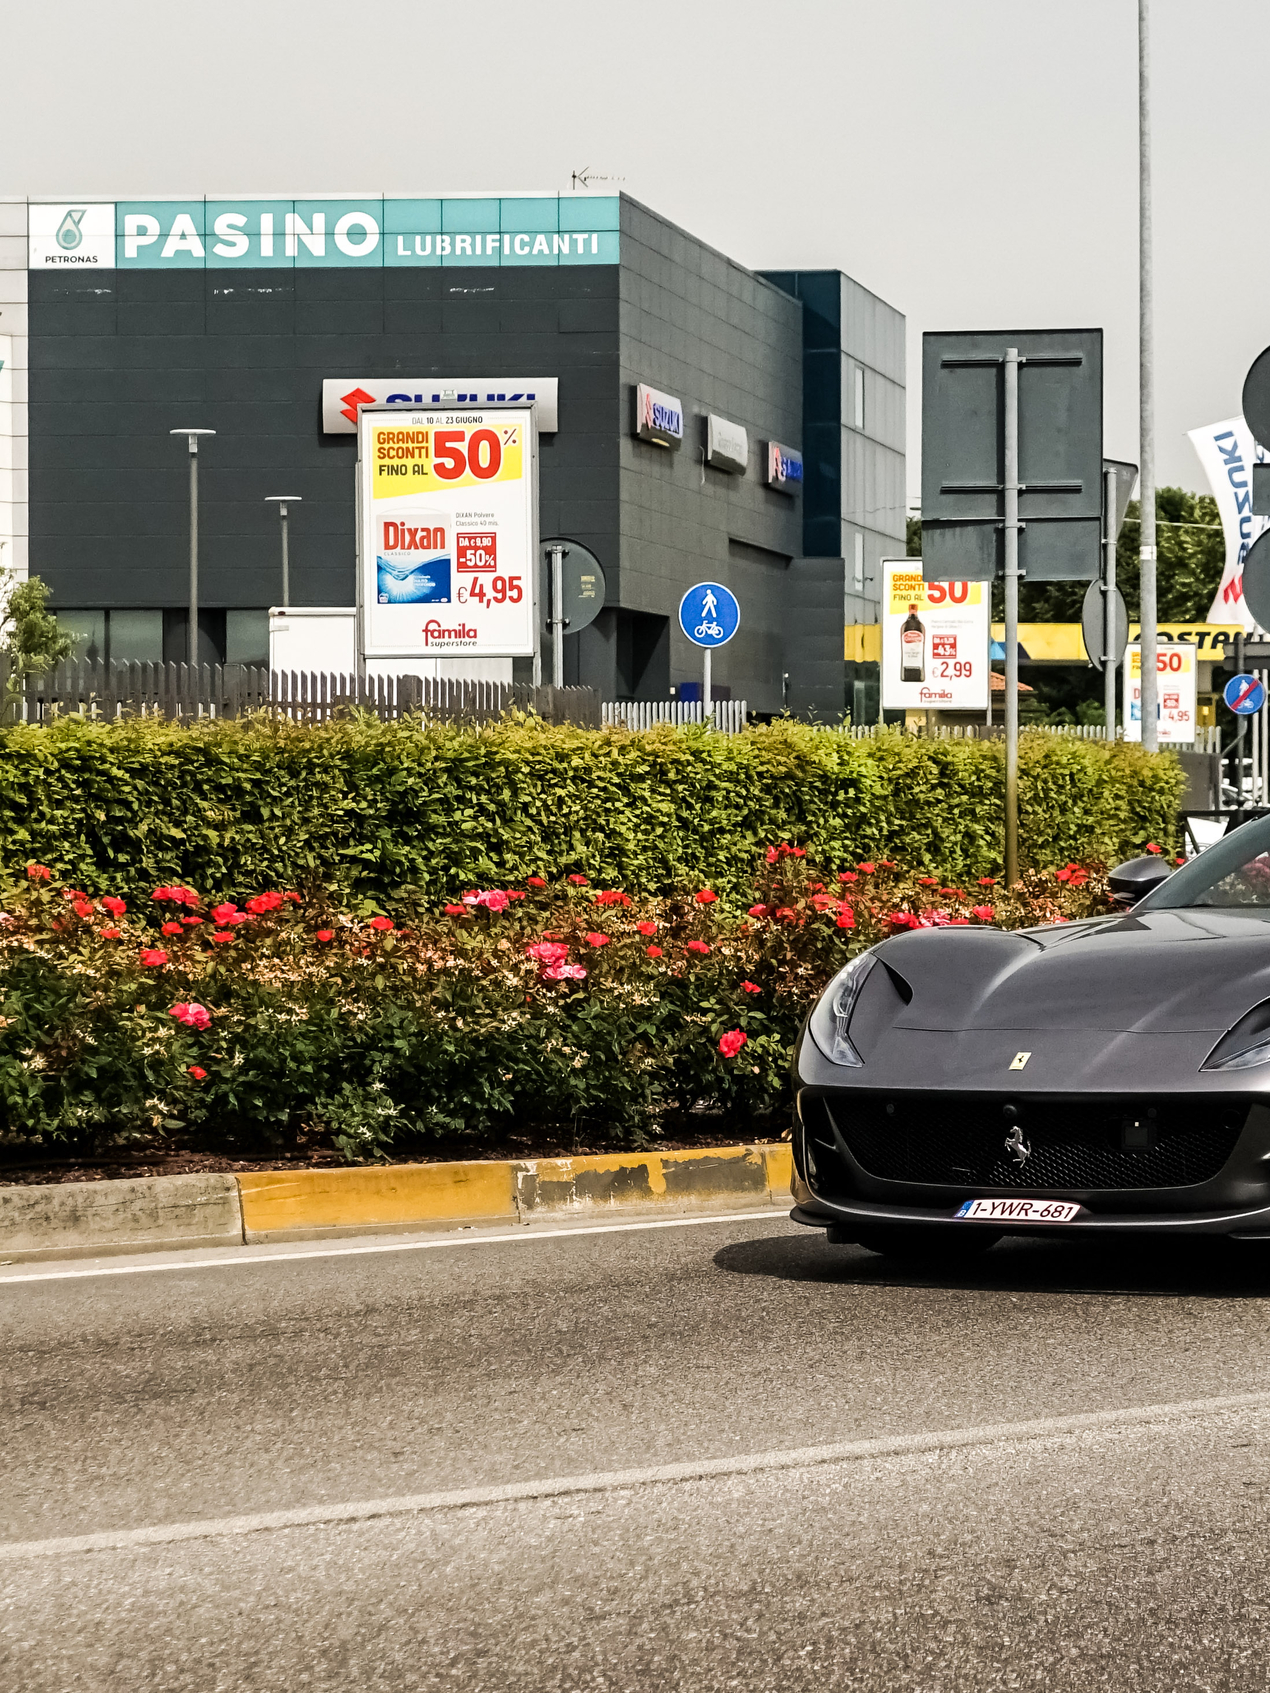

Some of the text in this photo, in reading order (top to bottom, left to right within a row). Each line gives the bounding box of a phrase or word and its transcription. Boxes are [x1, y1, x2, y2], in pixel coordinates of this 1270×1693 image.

[124, 211, 598, 258] PASINO LUBRIFICANTI
[45, 255, 98, 264] PETRONAS
[412, 417, 424, 425] DAL
[426, 416, 434, 424] 10
[445, 416, 454, 424] 23
[455, 416, 483, 424] GIUGNO
[377, 431, 428, 445] GRANDI
[377, 446, 429, 460] SCONTI
[379, 464, 428, 476] FINO AL
[383, 521, 446, 550] Dixan
[459, 537, 470, 547] DA
[459, 549, 495, 567] -50%
[892, 574, 923, 582] GRAND
[892, 583, 925, 591] SCONTI
[422, 619, 477, 646] famila
[430, 640, 477, 648] superstore
[934, 645, 956, 656] -43%
[919, 687, 953, 703] famila
[973, 1202, 1074, 1219] 1-YWR-681
